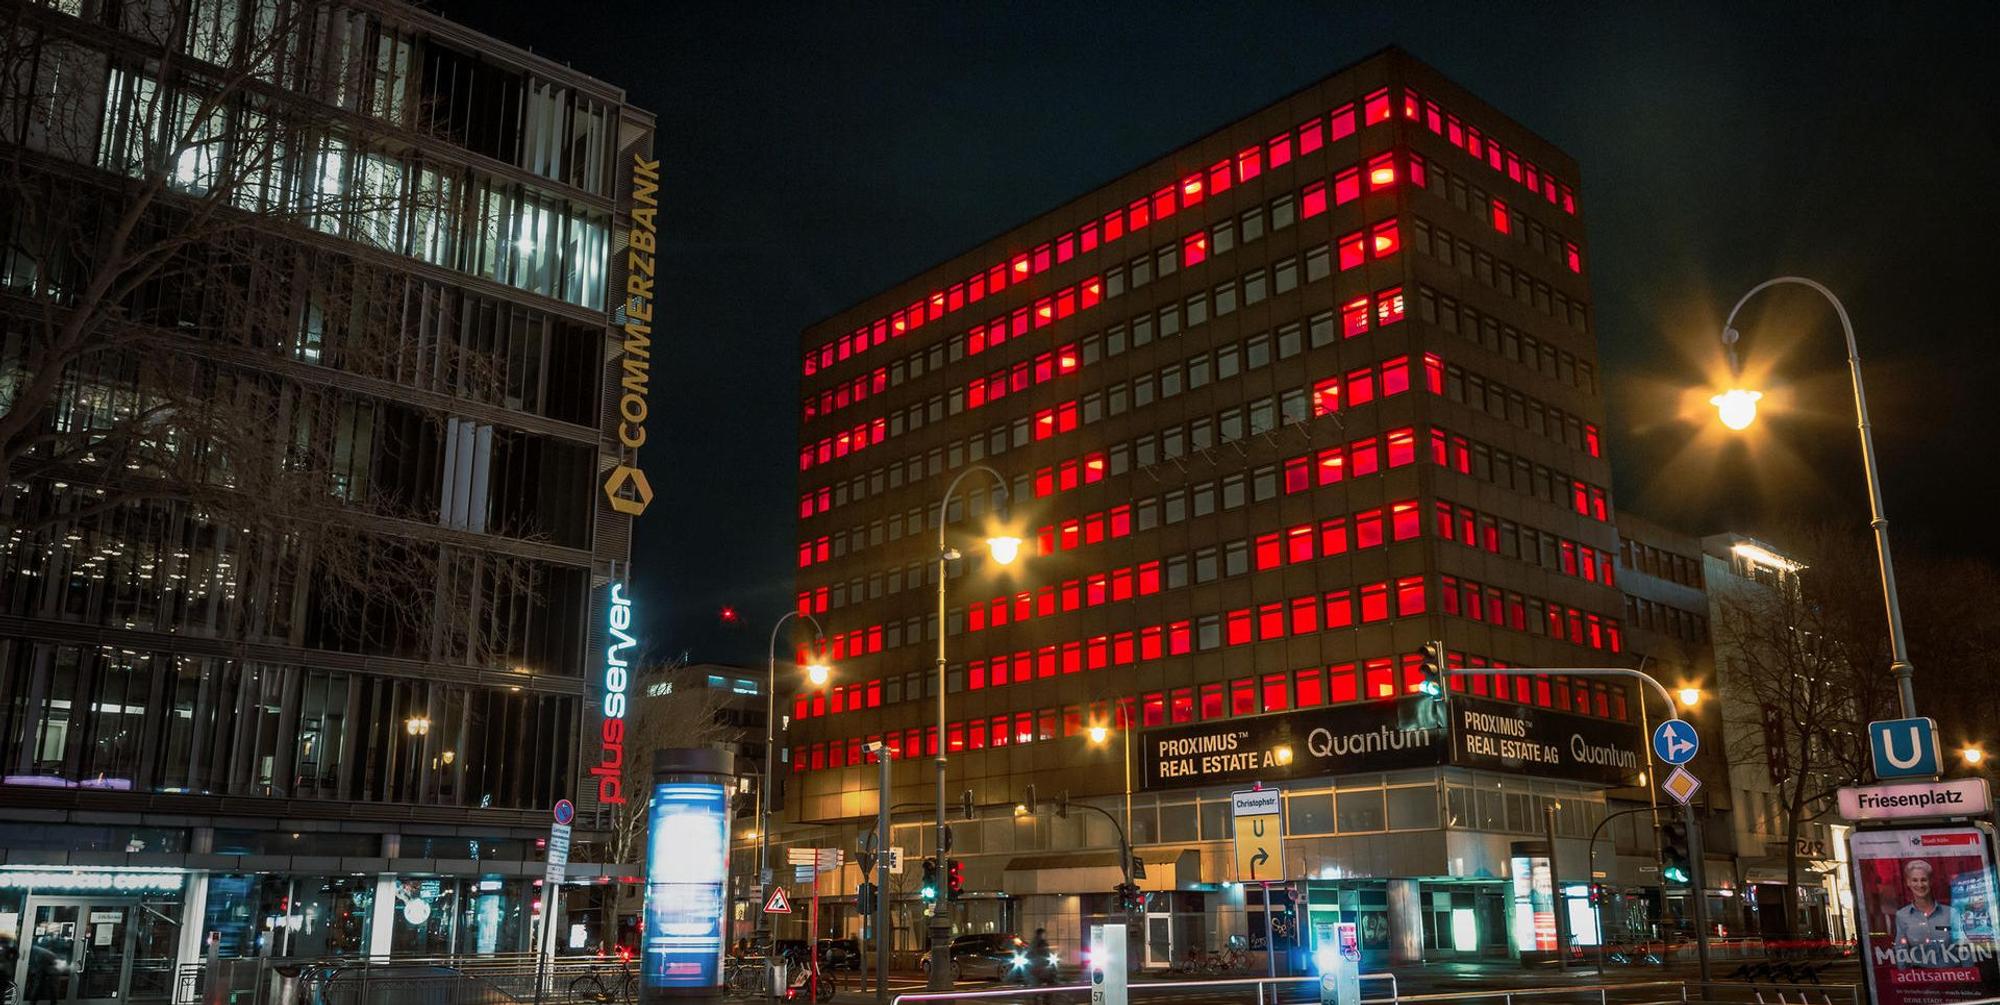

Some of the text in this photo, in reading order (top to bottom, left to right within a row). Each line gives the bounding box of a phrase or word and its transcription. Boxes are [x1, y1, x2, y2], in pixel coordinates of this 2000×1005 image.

[619, 153, 660, 448] COMMERZBANK
[589, 583, 637, 804] plusserver
[1308, 724, 1431, 758] Quantum
[1466, 734, 1559, 764] REAL ESTATE AG
[1571, 734, 1637, 769] Quantum
[1882, 727, 1922, 769] U
[1160, 755, 1197, 778] REAL
[1203, 751, 1258, 774] ESTATE
[1858, 789, 1963, 809] Friesenplatz
[1253, 819, 1264, 837] U
[1898, 969, 1975, 982] achtsamer.
[1093, 992, 1103, 1001] 57
